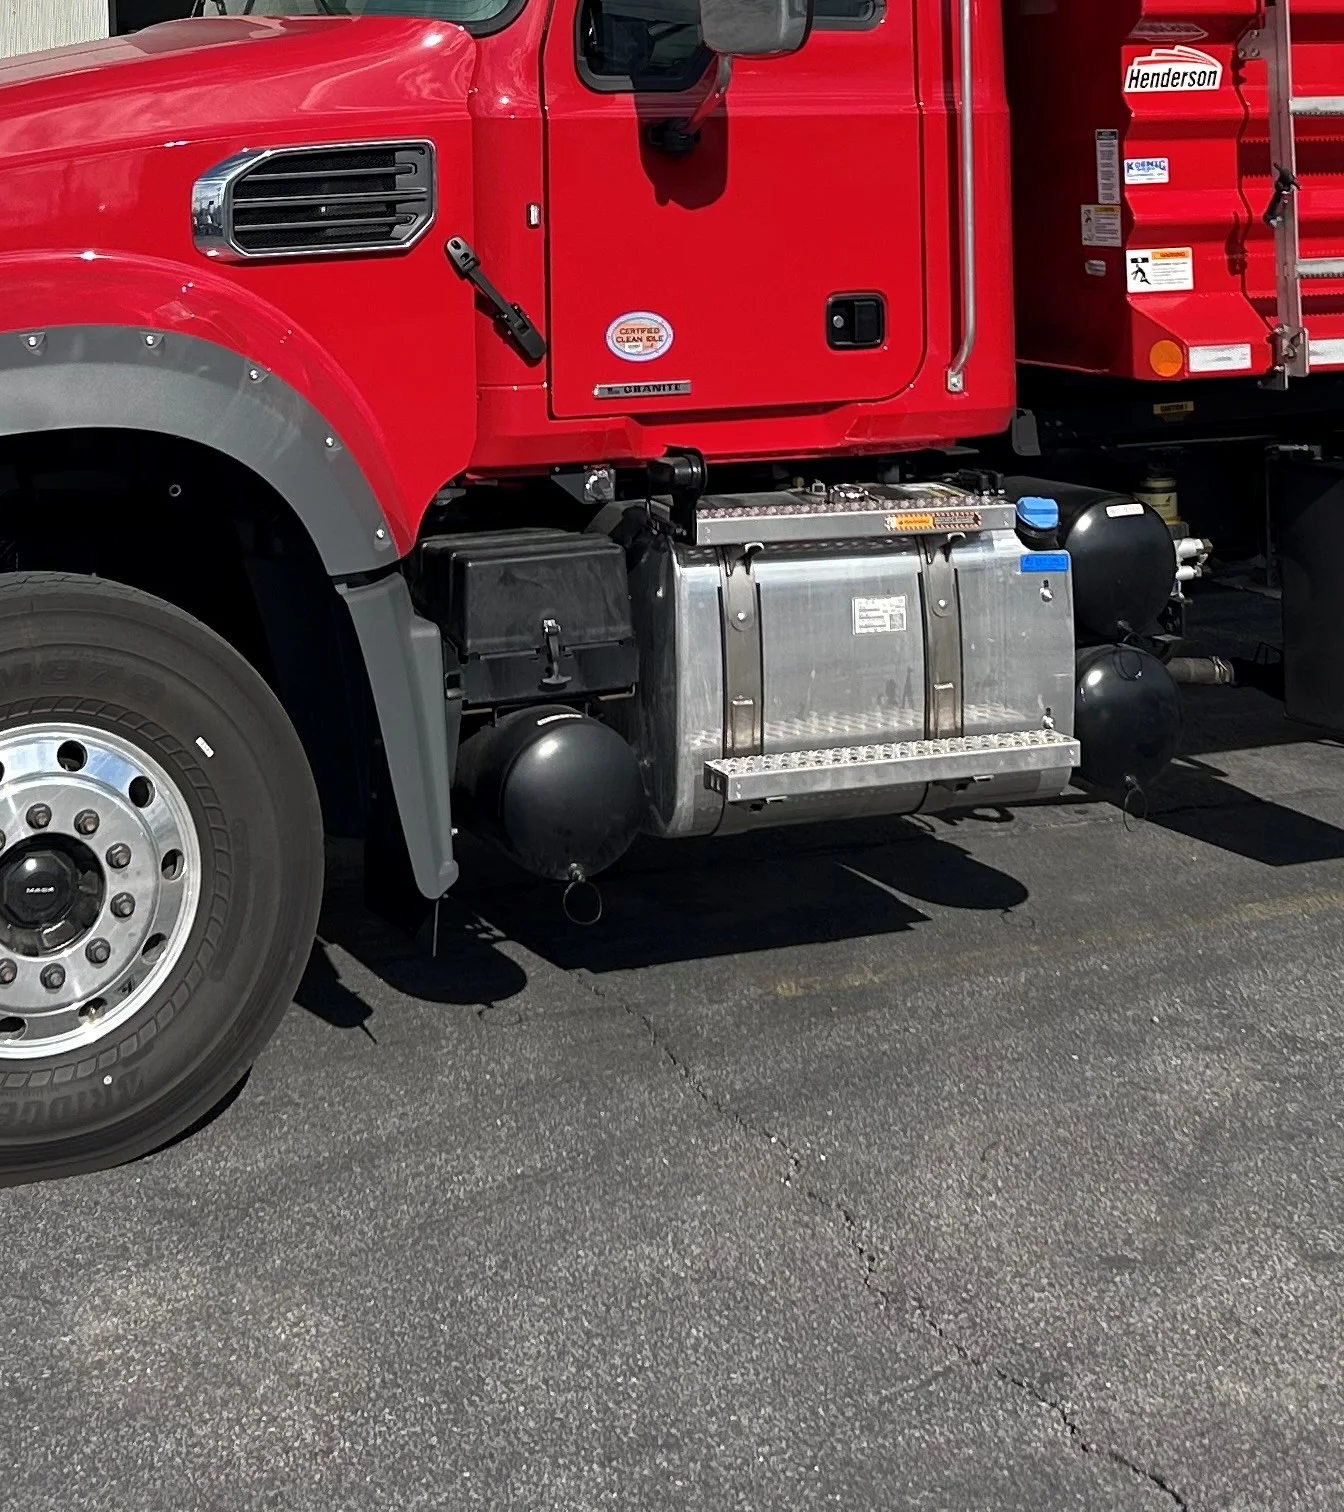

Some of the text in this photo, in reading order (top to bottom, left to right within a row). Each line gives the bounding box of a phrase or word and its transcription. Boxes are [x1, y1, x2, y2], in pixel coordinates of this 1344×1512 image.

[1127, 67, 1218, 90] Henderson
[619, 327, 660, 335] CERTIFIED
[615, 335, 643, 343] CLEAN
[623, 384, 681, 394] GRANITE
